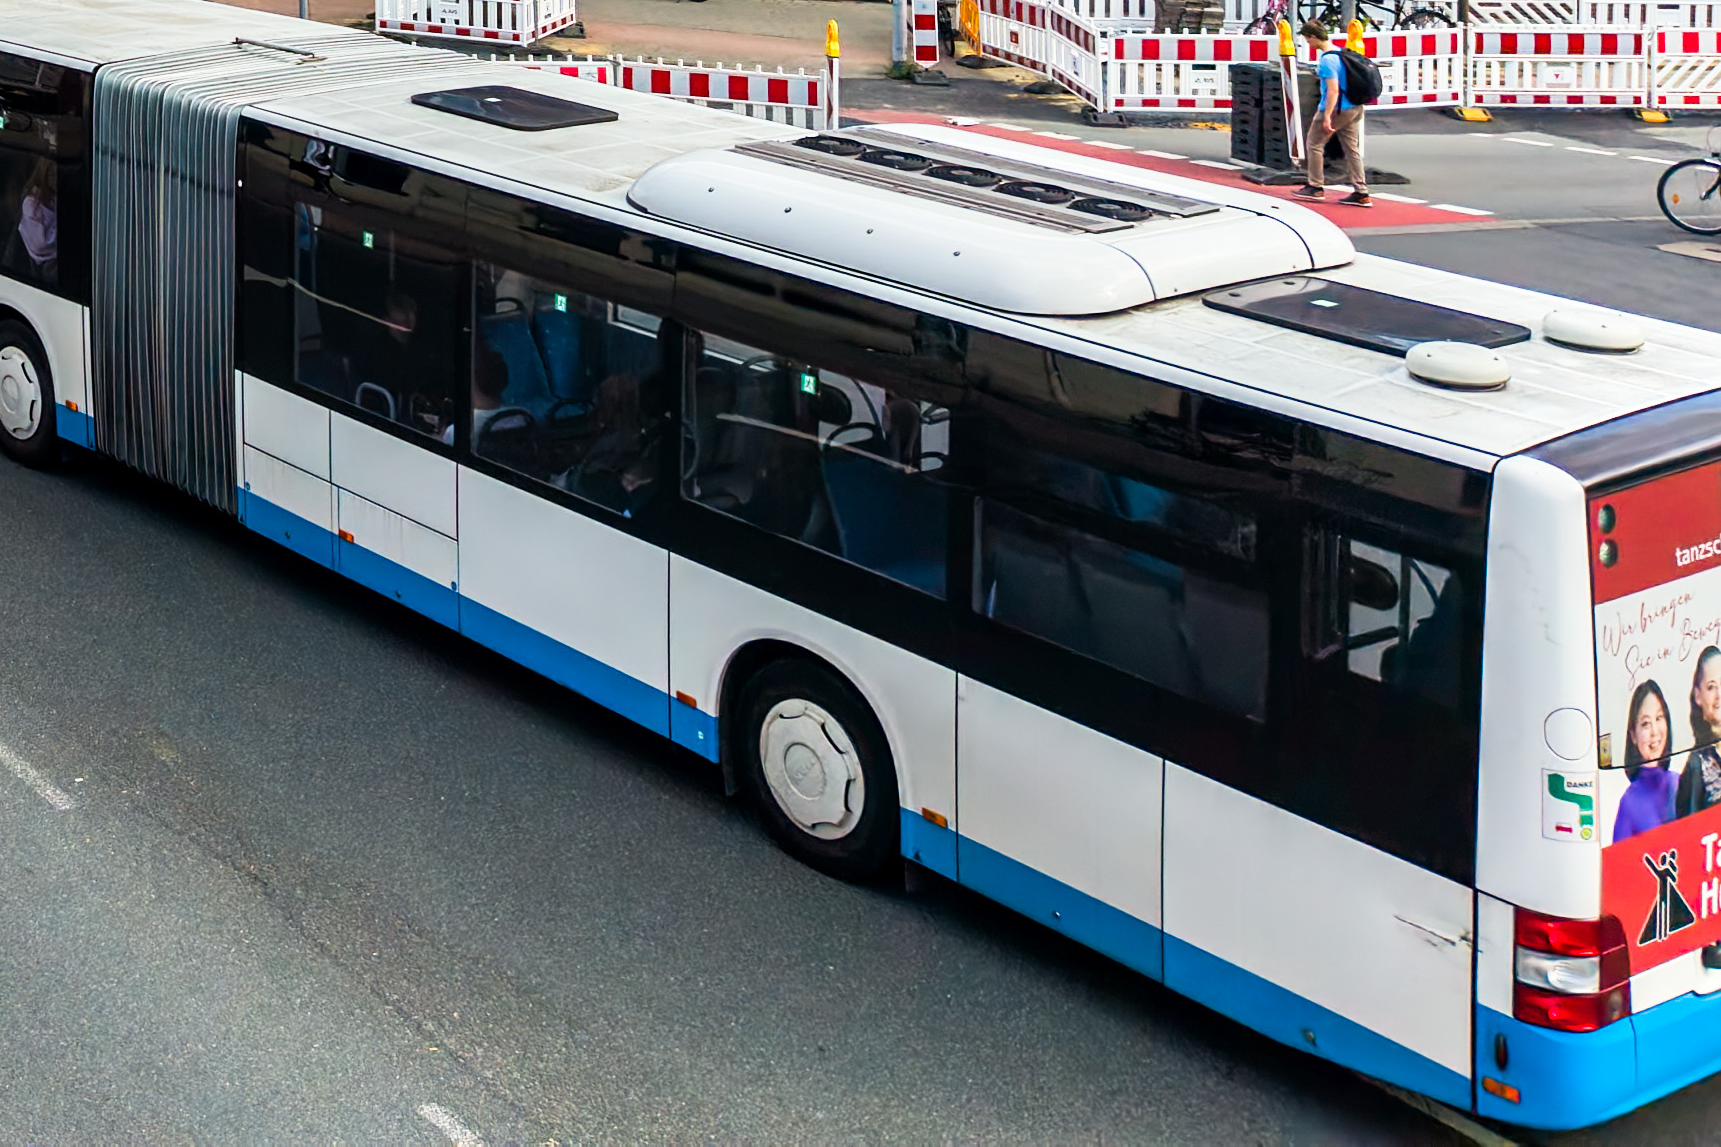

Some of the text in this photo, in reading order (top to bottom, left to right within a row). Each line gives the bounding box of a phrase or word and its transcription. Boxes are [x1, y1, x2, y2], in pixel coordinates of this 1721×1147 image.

[1675, 533, 1721, 567] tanzsc
[1603, 592, 1695, 656] Wir bringen
[1625, 644, 1655, 691] Sie
[1657, 648, 1672, 659] in
[1701, 877, 1721, 919] H
